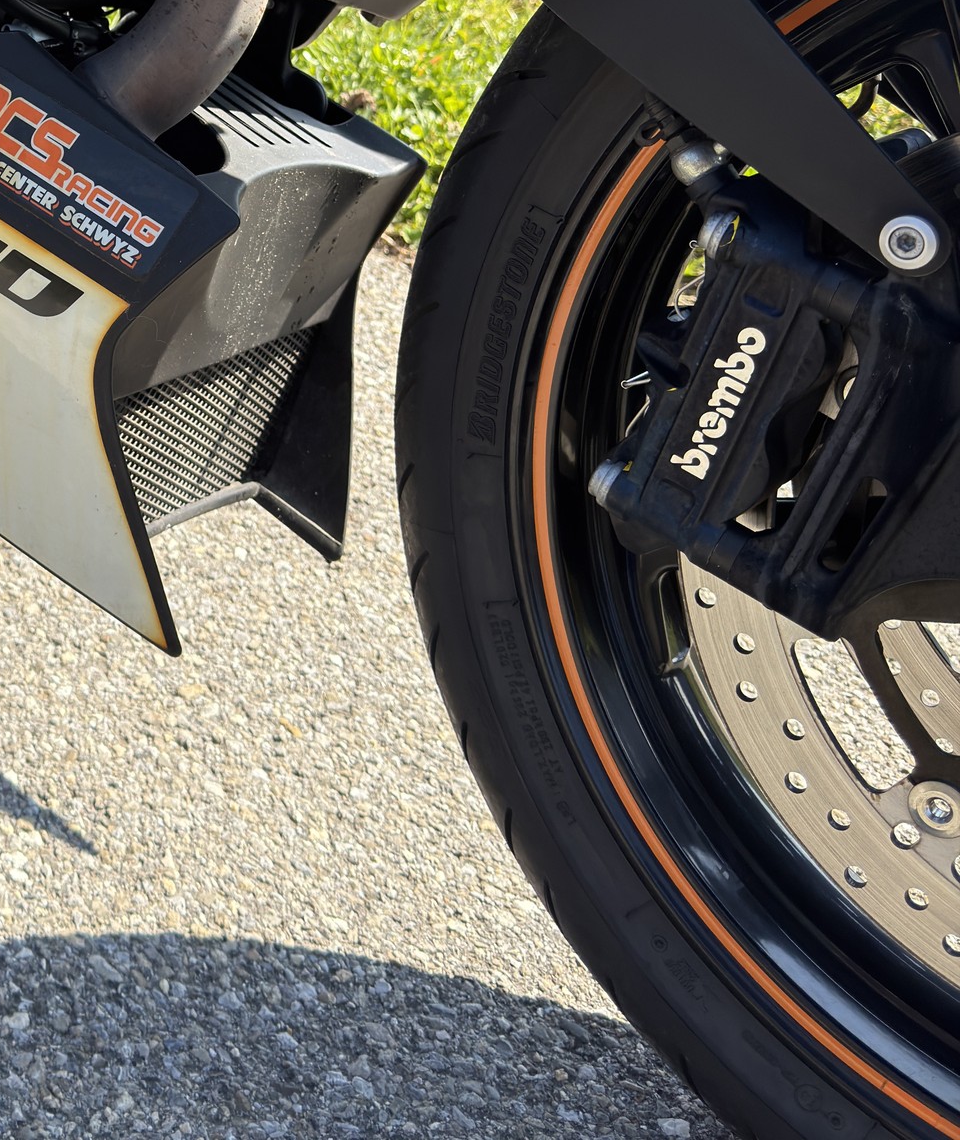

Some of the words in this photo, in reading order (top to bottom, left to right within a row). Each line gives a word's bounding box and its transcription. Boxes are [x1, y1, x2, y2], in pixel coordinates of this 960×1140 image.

[60, 205, 141, 267] SCHWYZ
[467, 217, 546, 446] BRIDGESTONE
[670, 327, 766, 480] brembo
